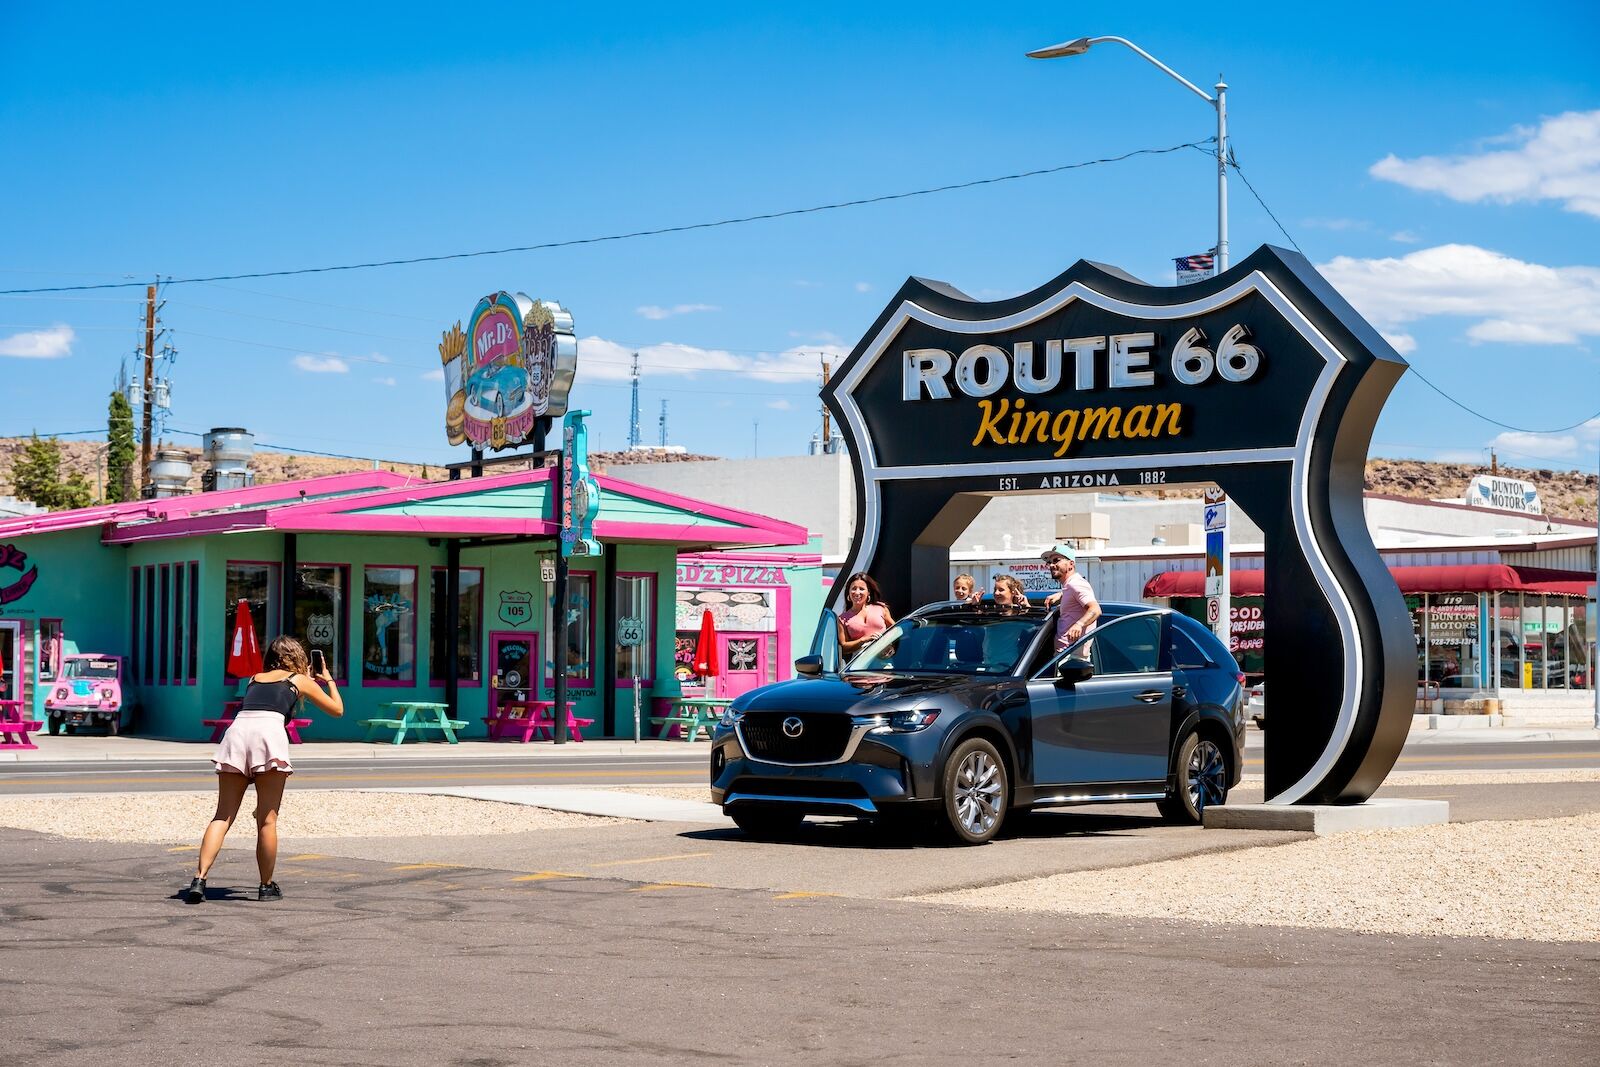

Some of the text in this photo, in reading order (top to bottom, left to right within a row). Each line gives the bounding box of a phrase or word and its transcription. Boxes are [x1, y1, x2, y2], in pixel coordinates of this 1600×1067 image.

[477, 322, 512, 360] Mr. D'z
[903, 323, 1260, 401] ROUTE 66
[493, 424, 504, 440] 66
[972, 398, 1182, 457] Kingman
[999, 471, 1166, 491] EST. ARIZONA 1882
[1491, 480, 1525, 496] DUNTON
[1491, 493, 1526, 510] MOTORS
[542, 568, 554, 580] 66
[716, 565, 788, 584] PIZZA
[1009, 564, 1039, 573] DUNTON
[1443, 596, 1463, 605] 119
[507, 606, 525, 616] 105
[1229, 607, 1262, 620] GOD
[1431, 612, 1477, 621] DUNTON
[313, 625, 329, 638] 66
[1430, 621, 1477, 630] MOTORS
[624, 628, 638, 639] 66
[501, 644, 527, 655] WELCOME
